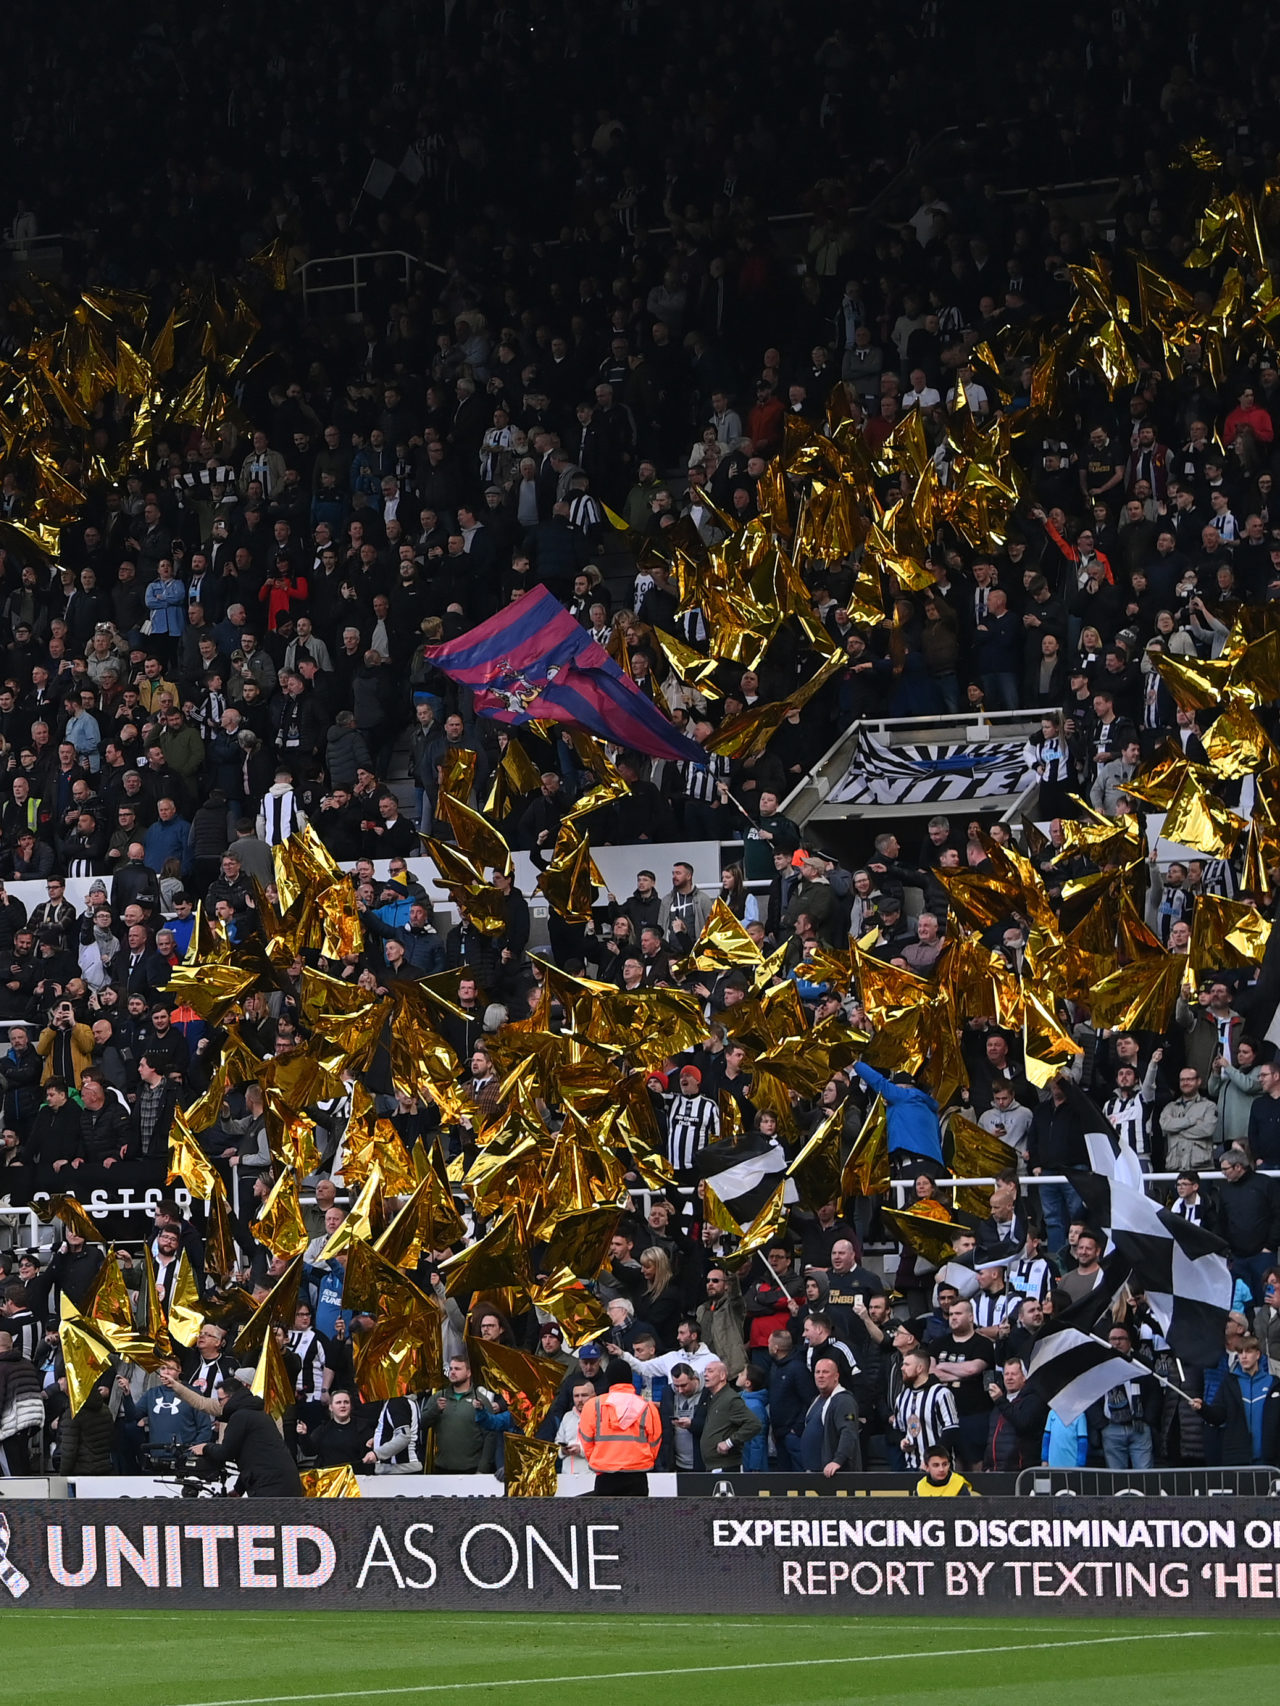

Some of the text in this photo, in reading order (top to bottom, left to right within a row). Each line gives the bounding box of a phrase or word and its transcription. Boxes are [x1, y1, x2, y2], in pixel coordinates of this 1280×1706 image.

[33, 1187, 210, 1220] STOR
[713, 1519, 945, 1547] EXPERIENCING
[954, 1519, 1236, 1548] DISCRIMINATION
[47, 1523, 622, 1590] UNITED AS ONE
[783, 1561, 934, 1596] REPORT
[945, 1561, 995, 1596] BY
[1003, 1562, 1189, 1598] TEXTING
